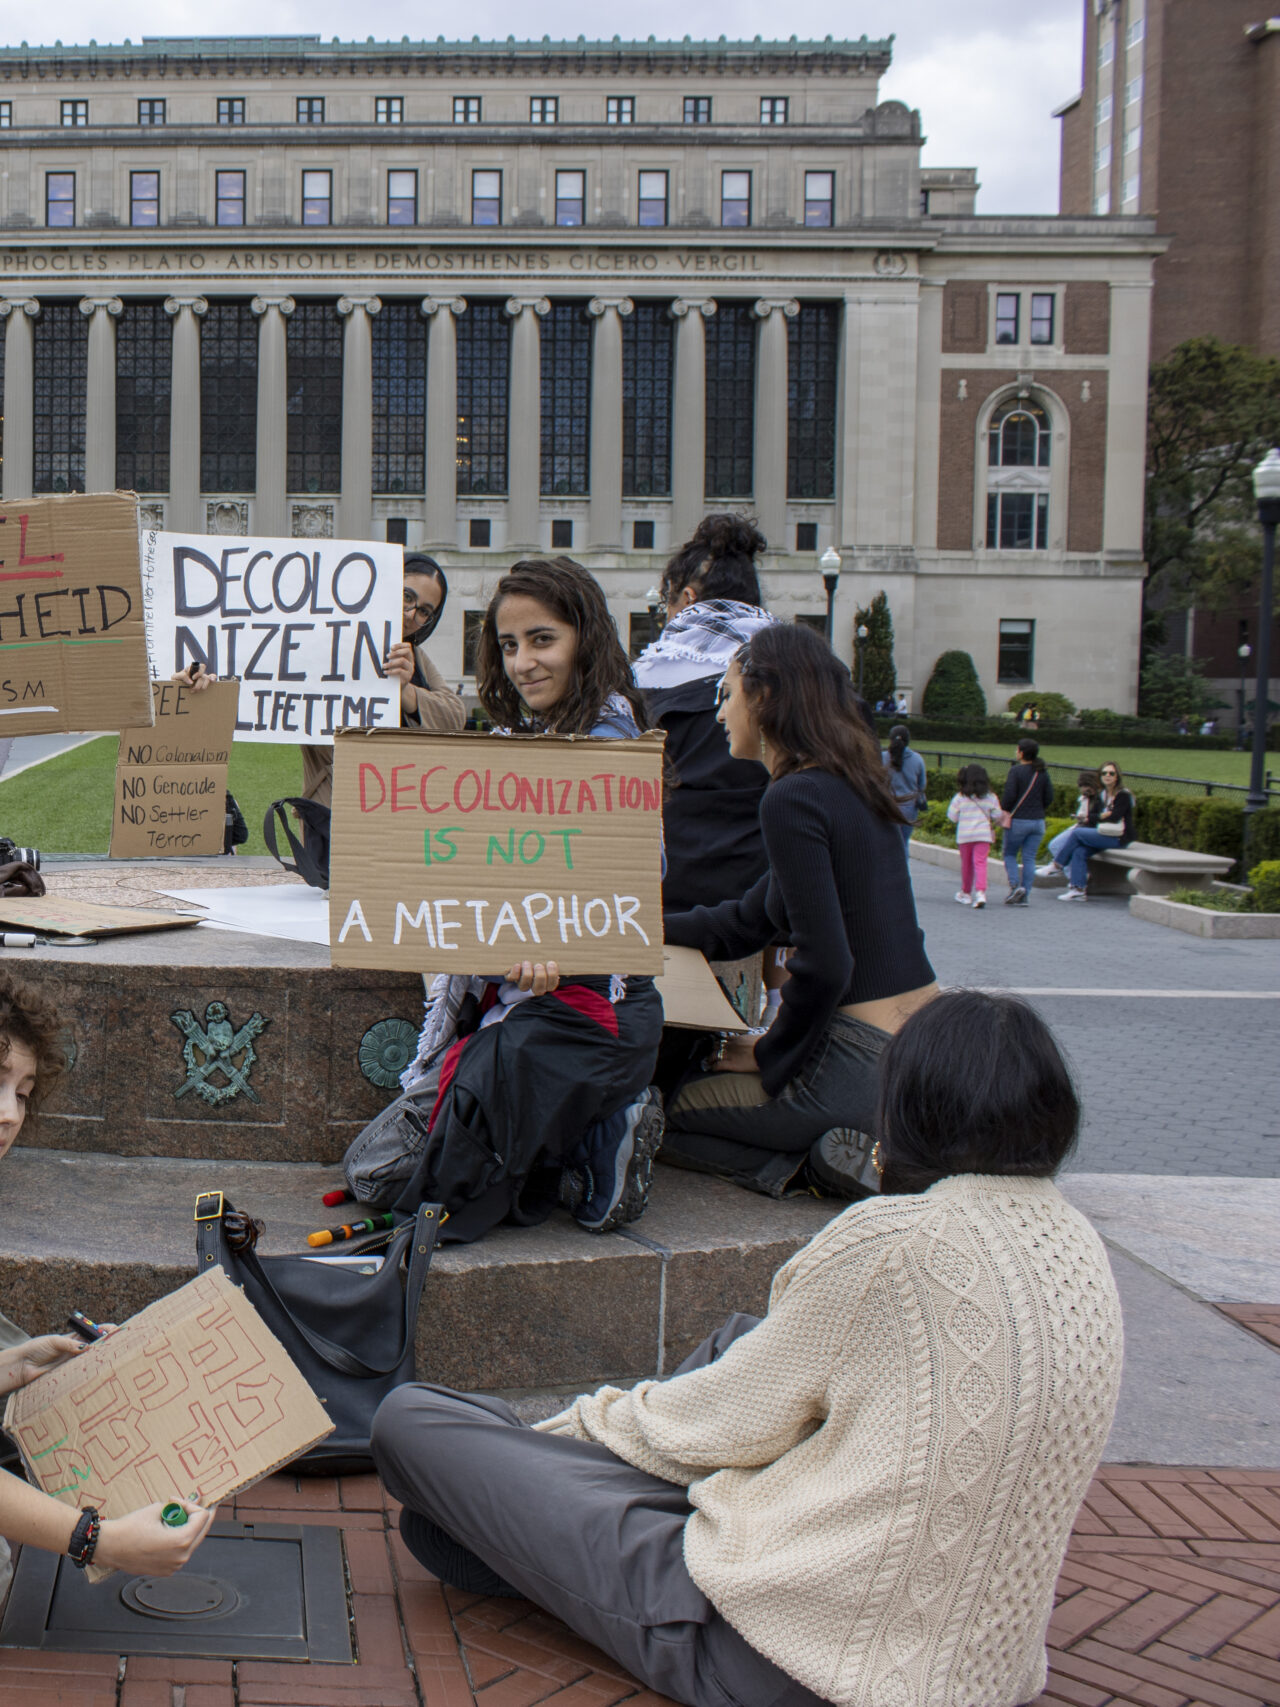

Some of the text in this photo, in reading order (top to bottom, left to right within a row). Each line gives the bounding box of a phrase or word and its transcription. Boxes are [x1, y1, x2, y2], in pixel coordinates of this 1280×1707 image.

[128, 253, 206, 270] PLATO
[227, 252, 357, 270] ARISTOTLE
[374, 252, 551, 270] DEMOSTHENES
[569, 253, 658, 271] CICERO
[675, 254, 763, 271] VERGIL
[173, 546, 377, 618] DECOLO
[175, 620, 392, 682] NIZE IN
[127, 744, 153, 764] NO
[122, 775, 216, 800] NO Genocide
[359, 763, 661, 815] DECOLONIZATION
[121, 804, 209, 825] NO Settler
[147, 830, 201, 849] Terror
[424, 826, 583, 870] IS NOT
[338, 892, 650, 950] A METAPHOR
